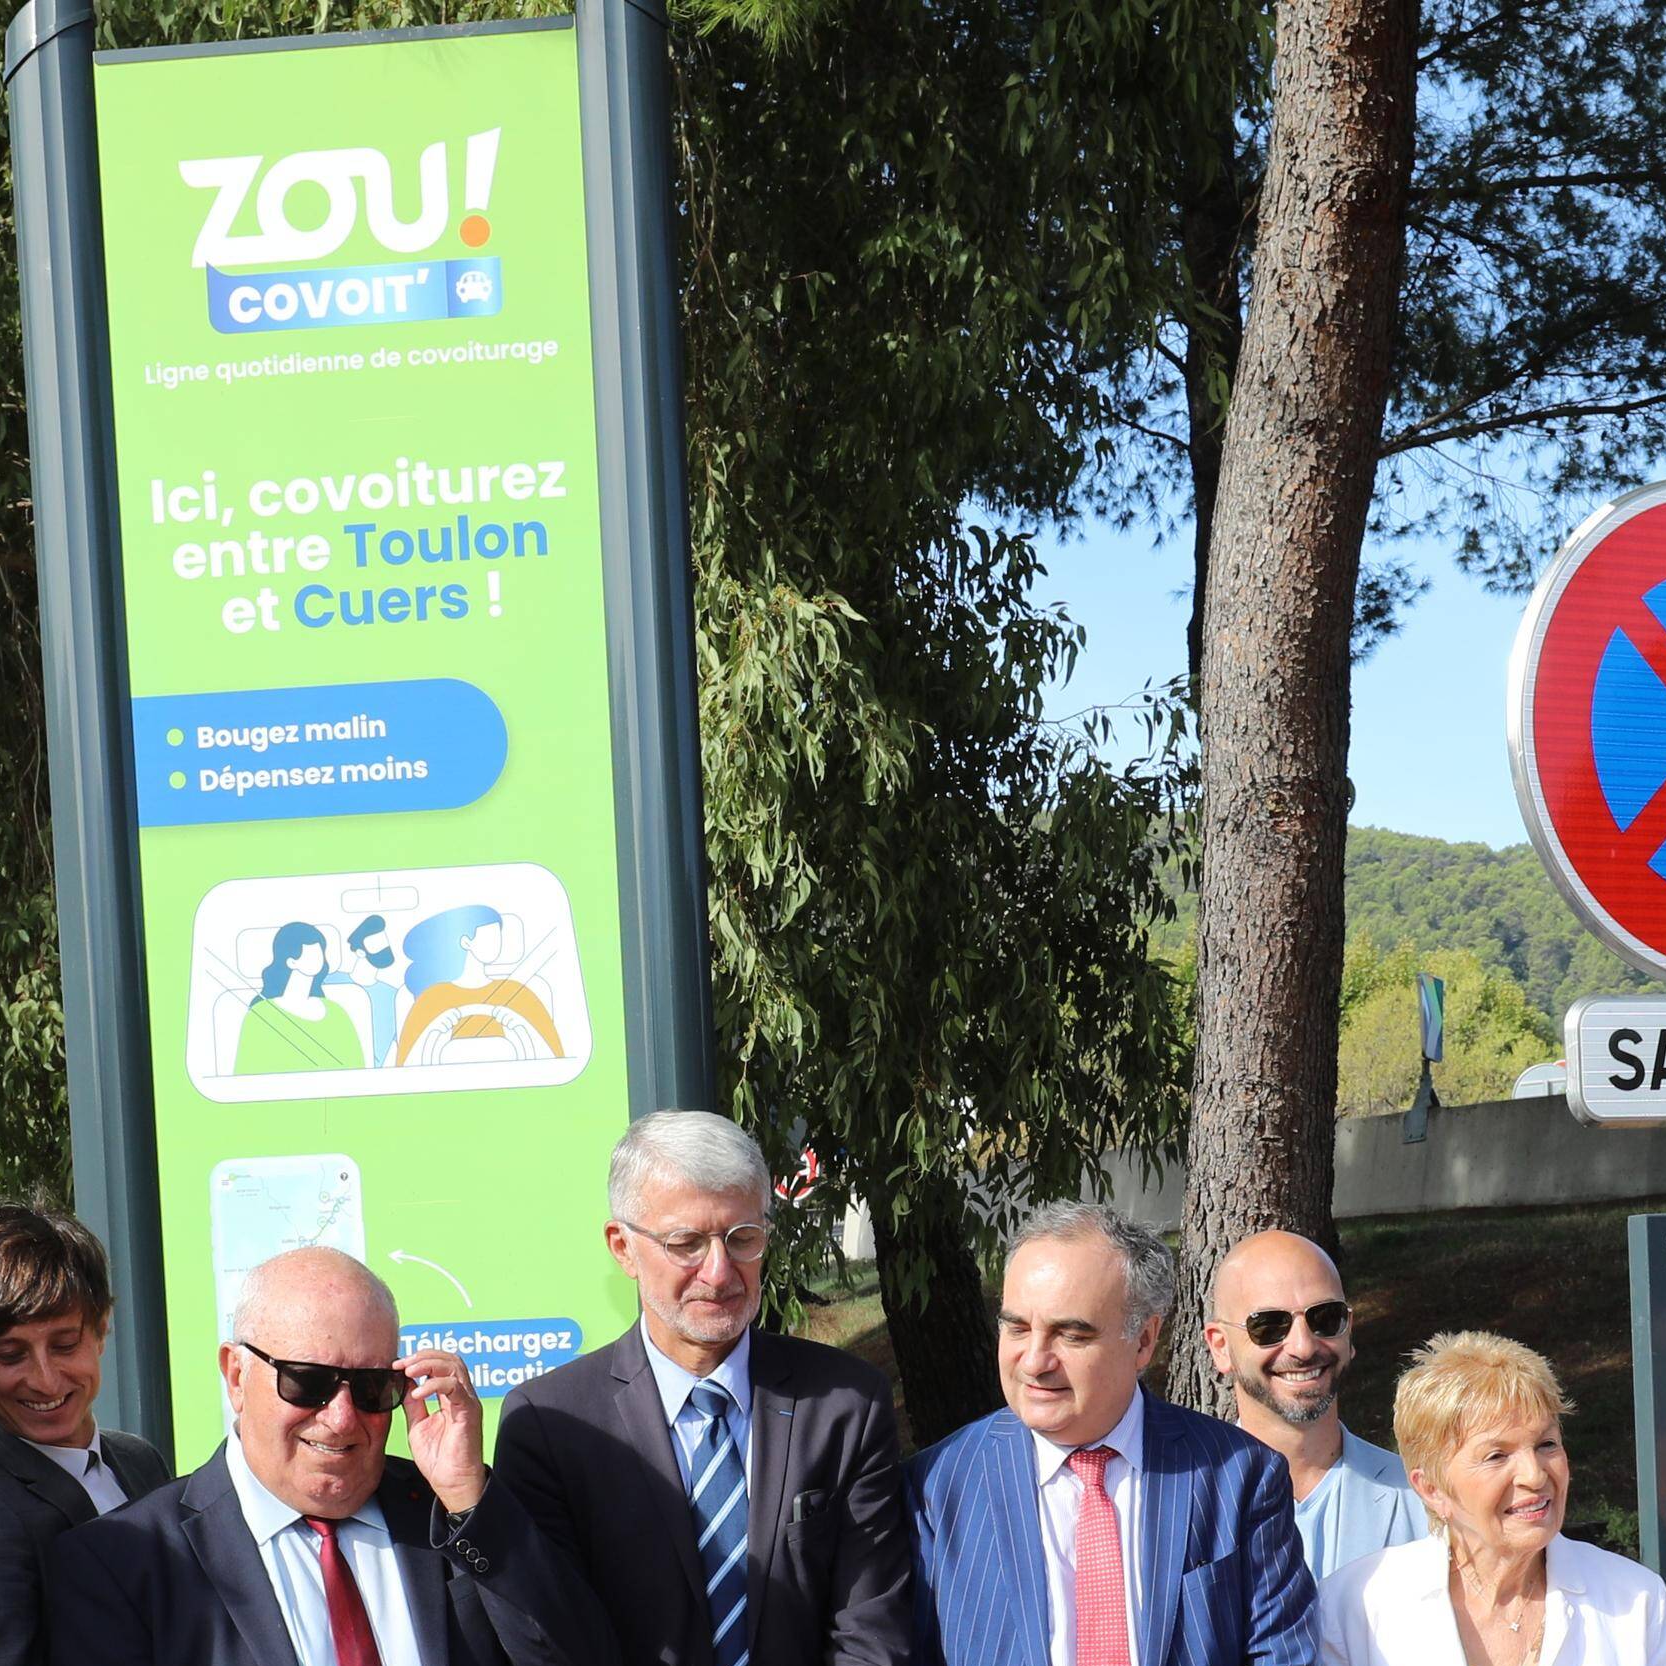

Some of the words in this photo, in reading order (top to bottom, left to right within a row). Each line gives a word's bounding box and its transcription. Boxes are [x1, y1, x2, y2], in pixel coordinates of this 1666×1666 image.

[178, 126, 501, 269] ZOU!
[145, 363, 209, 389] Ligne
[215, 352, 364, 385] quotidienne
[369, 346, 401, 368] de
[407, 339, 558, 366] covoiturage
[150, 470, 234, 527] Ici,
[248, 456, 567, 517] covoiturez
[172, 530, 331, 580] entre
[343, 515, 549, 568] Toulon
[221, 587, 280, 634] et
[293, 583, 470, 629] Cuers
[487, 570, 503, 618] !
[197, 723, 299, 752] Bougez
[305, 714, 387, 742] malin
[199, 765, 334, 797] Dépensez
[341, 755, 429, 783] moins
[399, 1330, 573, 1358] Téléchargez
